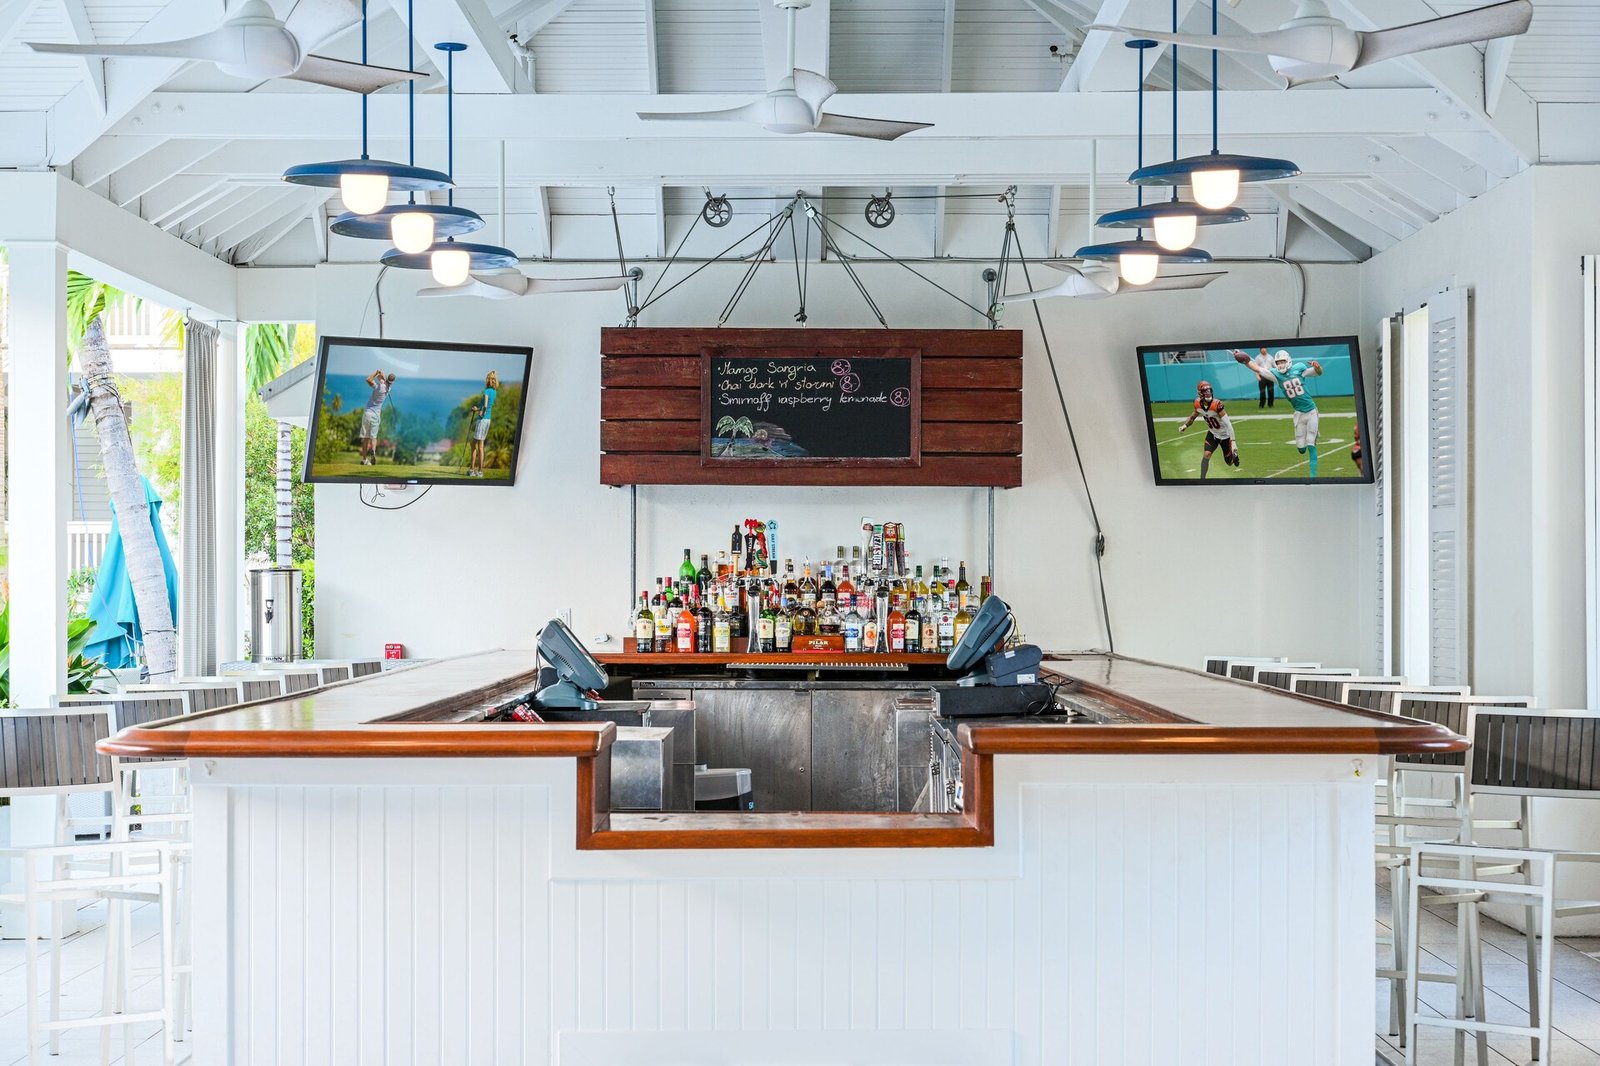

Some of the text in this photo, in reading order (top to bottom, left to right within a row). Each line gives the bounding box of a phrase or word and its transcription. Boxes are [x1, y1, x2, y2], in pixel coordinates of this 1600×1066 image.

[720, 361, 758, 382] Mango
[766, 361, 817, 381] Sangria
[749, 377, 775, 389] dark
[1283, 377, 1305, 399] 88
[720, 392, 772, 412] Smirnoff
[778, 393, 832, 412] raspberry
[839, 392, 888, 403] lemonade
